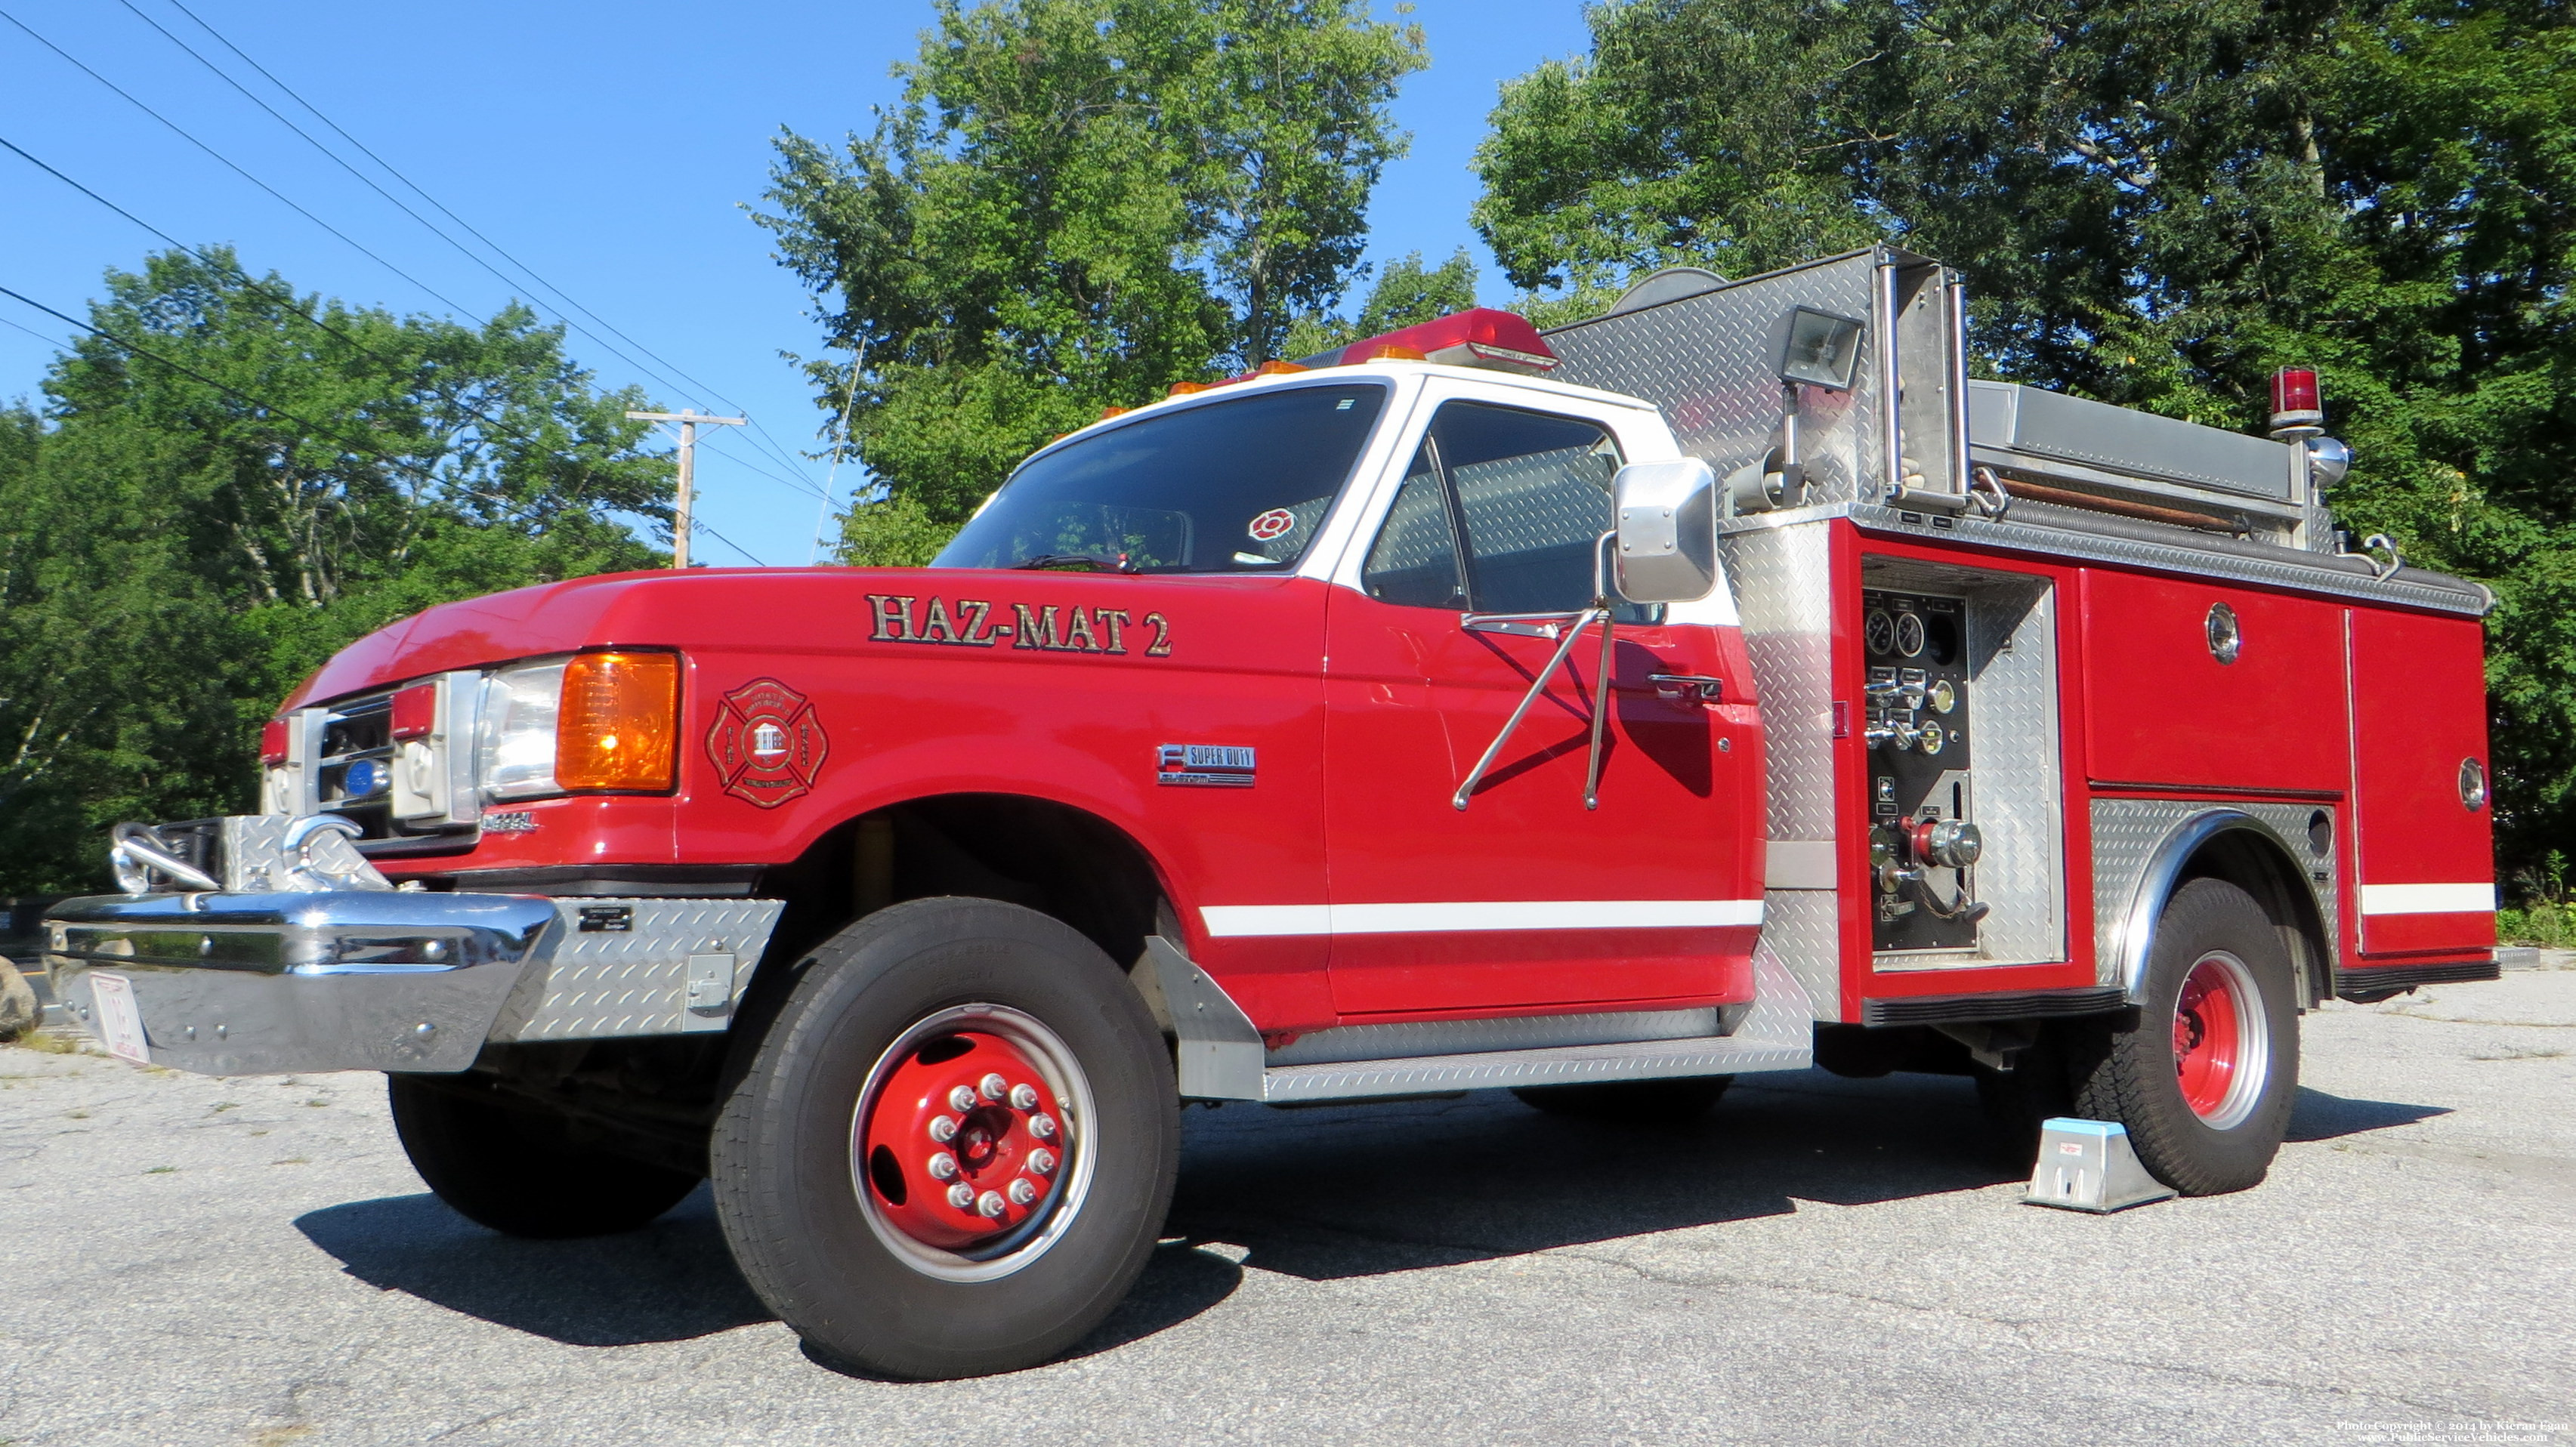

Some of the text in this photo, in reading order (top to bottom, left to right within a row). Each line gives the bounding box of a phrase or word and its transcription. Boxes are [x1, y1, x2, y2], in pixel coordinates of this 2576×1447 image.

[863, 593, 1174, 657] HAZ-MAT 2
[1191, 747, 1224, 765] SUPER
[1227, 748, 1251, 766] DUTY
